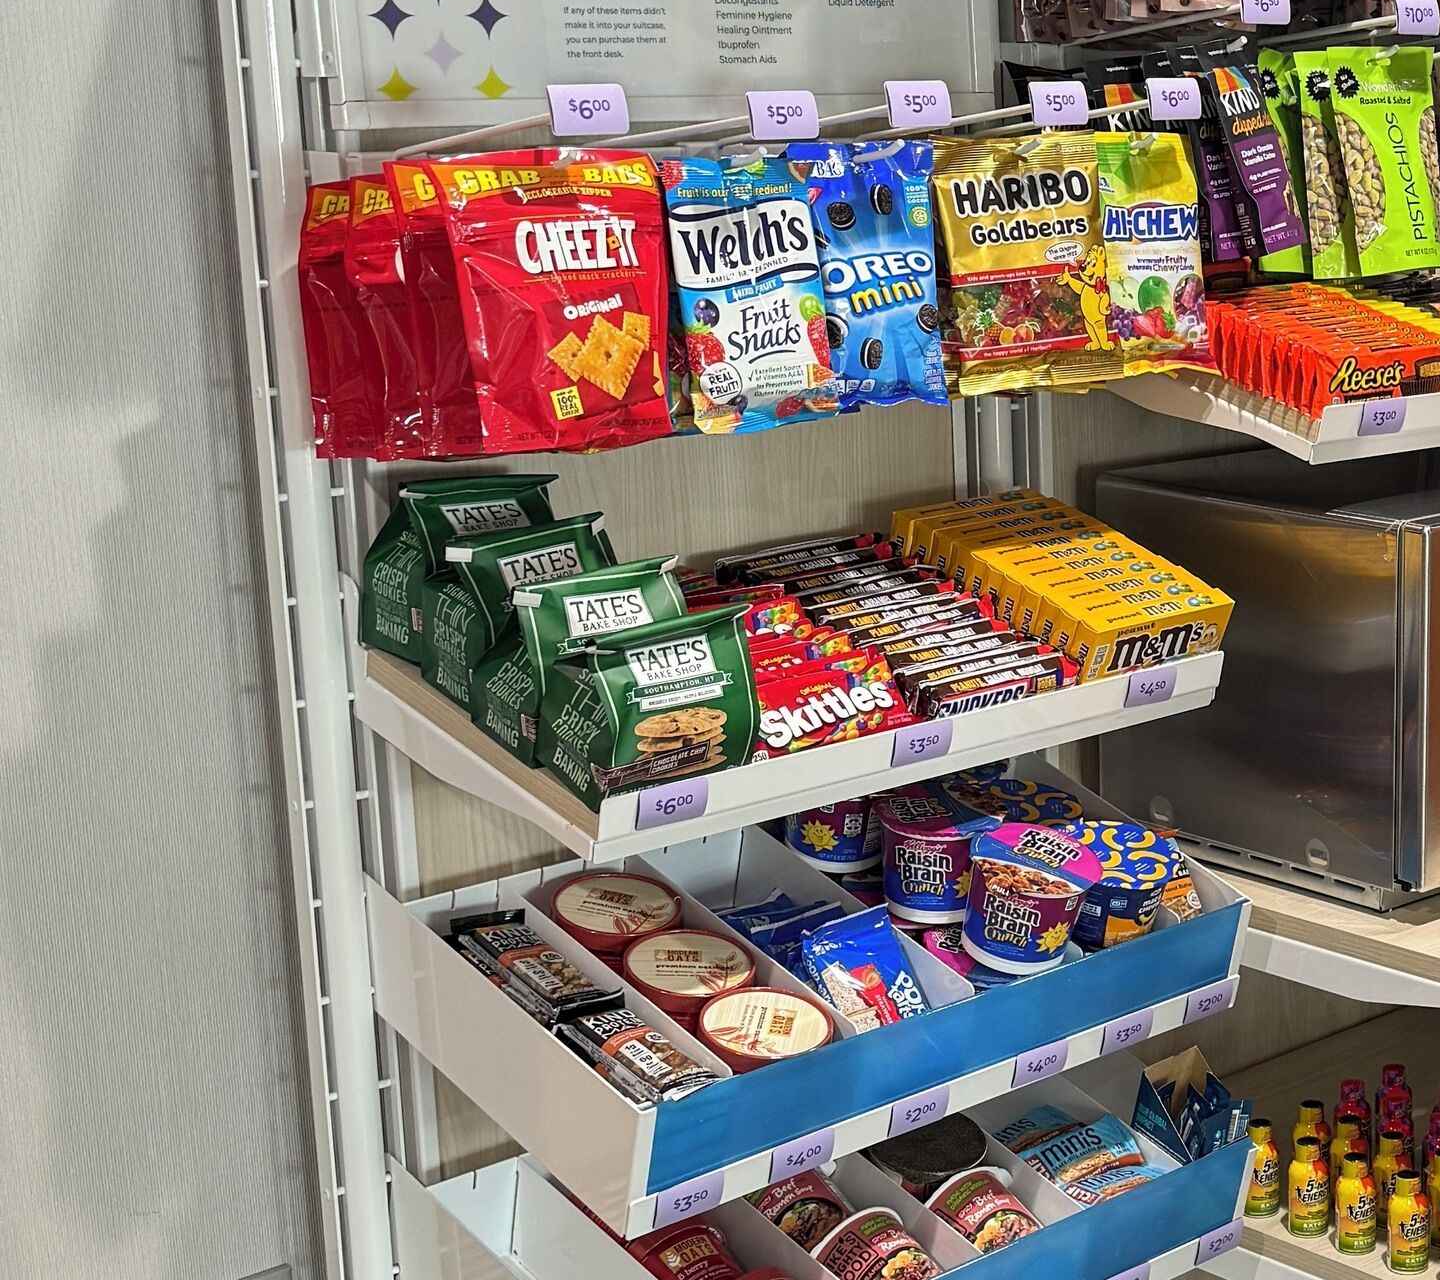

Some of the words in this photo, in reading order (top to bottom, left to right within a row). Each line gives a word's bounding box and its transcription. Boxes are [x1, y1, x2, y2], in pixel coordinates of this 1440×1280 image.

[571, 8, 586, 17] any
[596, 6, 619, 15] these
[620, 7, 643, 15] items
[716, 10, 756, 20] Feminine
[758, 11, 793, 22] Hygiene
[565, 21, 587, 29] make
[596, 21, 613, 29] into
[613, 22, 631, 31] your
[717, 25, 750, 37] Healing
[751, 25, 793, 35] Ointment
[566, 37, 581, 46] you
[599, 36, 635, 45] purchase
[636, 36, 658, 44] them
[718, 40, 760, 51] Ibuprofen
[567, 50, 581, 58] the
[582, 50, 602, 58] front
[719, 55, 758, 64] Stomach
[759, 55, 777, 64] Aids
[1219, 88, 1260, 117] KIND
[452, 168, 541, 196] GRAB
[583, 165, 654, 187] BAGS
[1384, 111, 1428, 241] PISTACHIOS
[952, 169, 1090, 217] HARIBO
[677, 208, 809, 276] Welch's
[970, 216, 1088, 245] Goldbears
[822, 252, 933, 295] OREO
[1165, 255, 1188, 267] Fruity
[851, 275, 923, 315] mini
[740, 296, 792, 334] Fruit
[727, 320, 802, 362] Snacks
[708, 372, 734, 386] REAL
[1329, 357, 1402, 393] Reese's
[709, 380, 740, 398] FRUIT!
[1116, 623, 1156, 637] peanut
[630, 640, 708, 672] TATE'S
[1106, 621, 1205, 673] m&m's
[646, 670, 673, 681] BAKE
[674, 663, 702, 676] SHOP
[759, 681, 896, 748] Skittles
[653, 750, 690, 767] CHOCOLATE
[690, 746, 706, 758] CHIP
[552, 747, 591, 792] BAKING
[984, 895, 1041, 927] Raisin
[984, 927, 1030, 948] Crunch
[986, 911, 1032, 939] Bran
[584, 1008, 637, 1030] KIND
[594, 1016, 647, 1036] PROTEIN
[1040, 1126, 1103, 1166] minis
[975, 1190, 996, 1207] Beef
